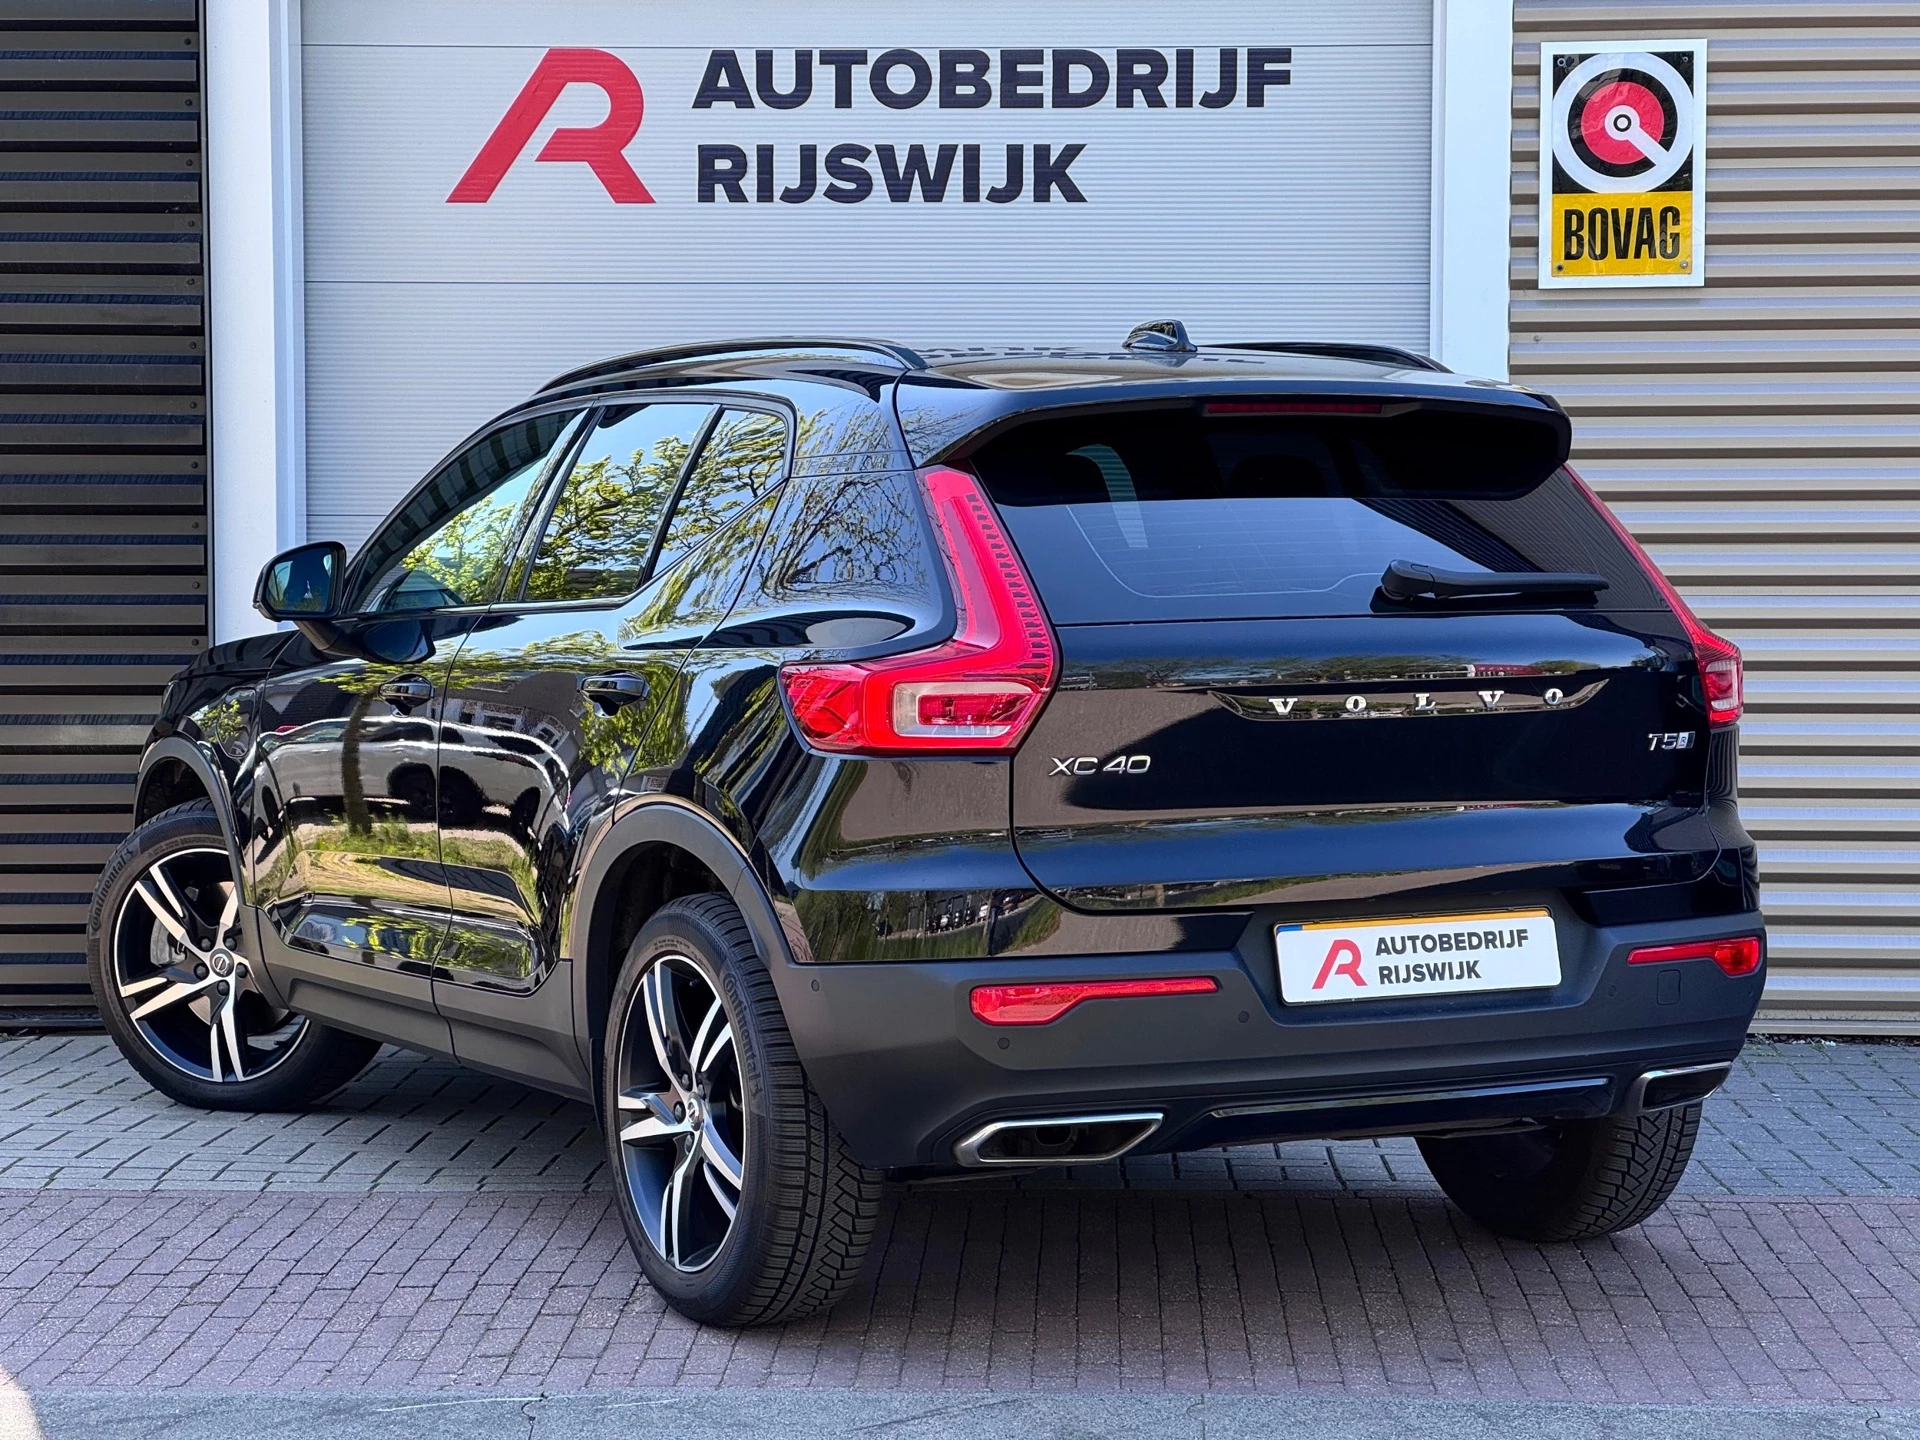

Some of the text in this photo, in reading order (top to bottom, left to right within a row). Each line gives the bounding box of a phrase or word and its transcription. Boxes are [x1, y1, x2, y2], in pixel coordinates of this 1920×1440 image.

[692, 48, 1292, 109] AUTOBEDRIJF
[697, 144, 1087, 204] RIJSWIJK
[1563, 205, 1681, 261] BOVAG
[1268, 687, 1564, 716] VOLVO
[91, 854, 127, 932] Continental
[1375, 929, 1529, 956] AUTOBEDRIJF
[1379, 960, 1482, 985] RIJSWIJK
[722, 972, 762, 1081] Continental
